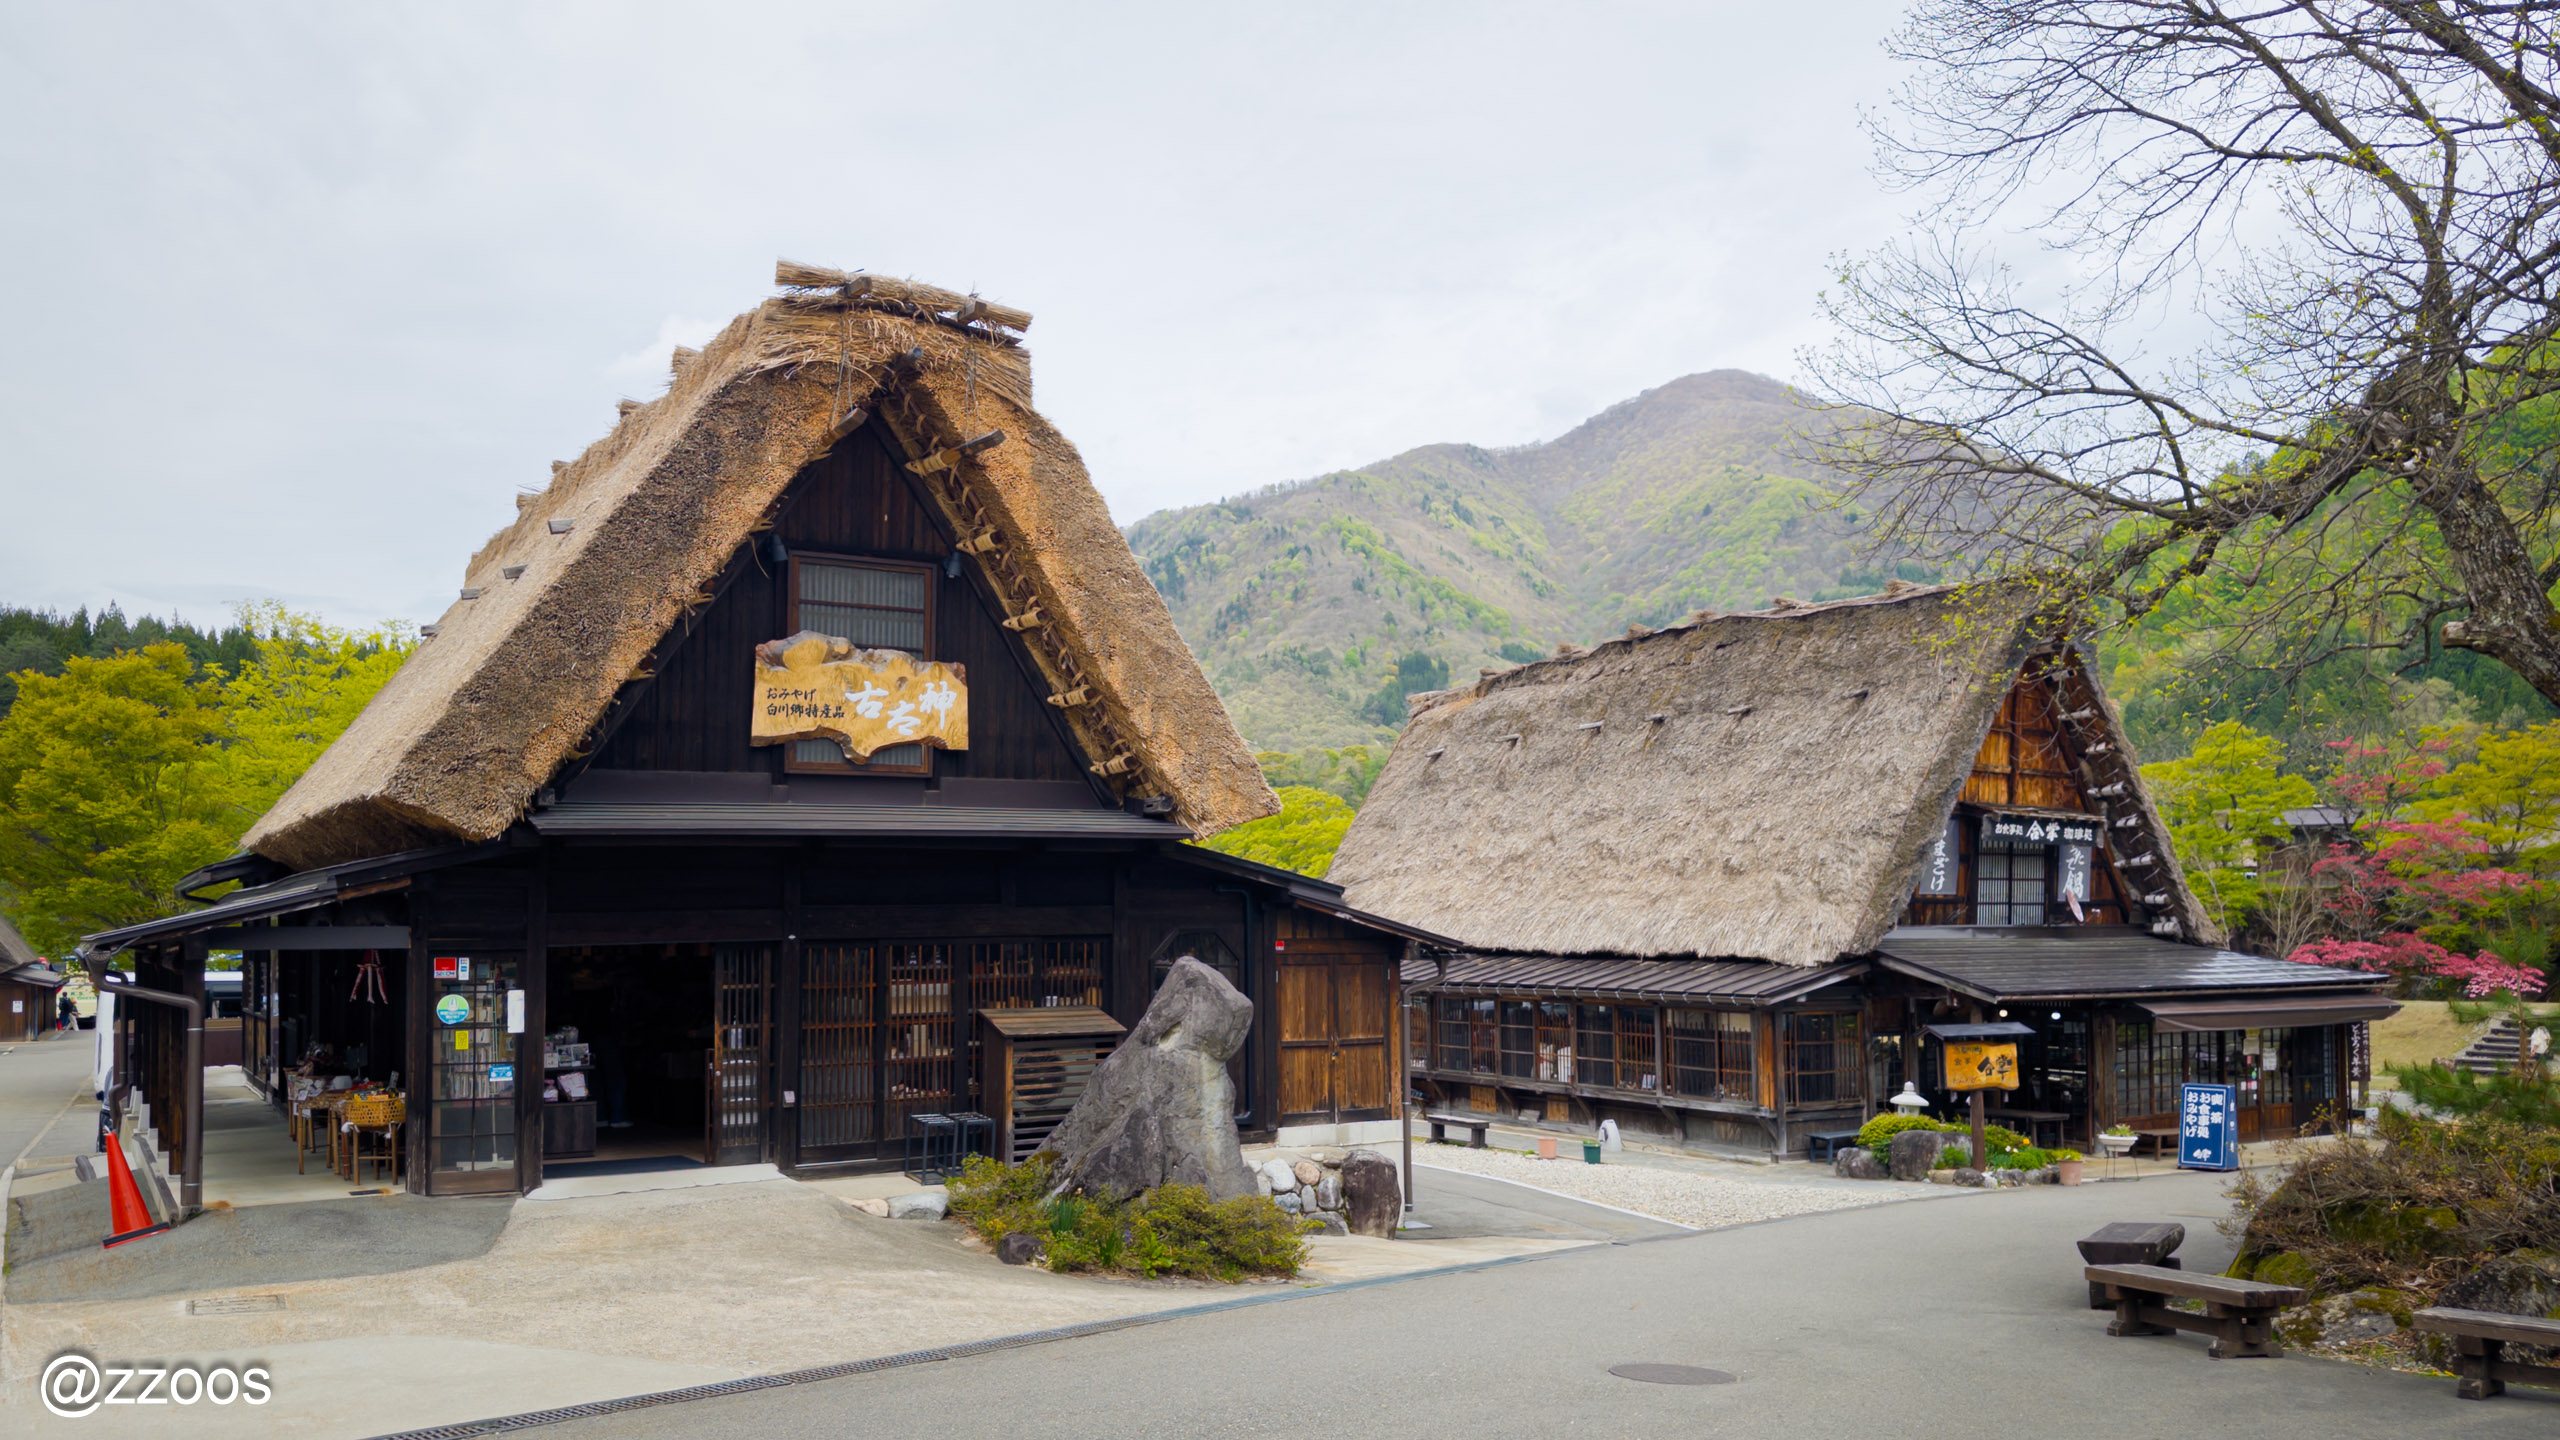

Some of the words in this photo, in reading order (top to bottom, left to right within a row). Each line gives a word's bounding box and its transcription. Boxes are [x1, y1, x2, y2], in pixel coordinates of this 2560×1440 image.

[767, 688, 817, 701] おみやげ
[766, 703, 845, 719] 白川郷特産品
[1995, 823, 2024, 836] お食事処
[1930, 829, 1950, 891] まざけ
[2185, 1091, 2198, 1138] おみやげ
[2197, 1092, 2211, 1139] お食事処
[2210, 1093, 2224, 1124] 喫茶
